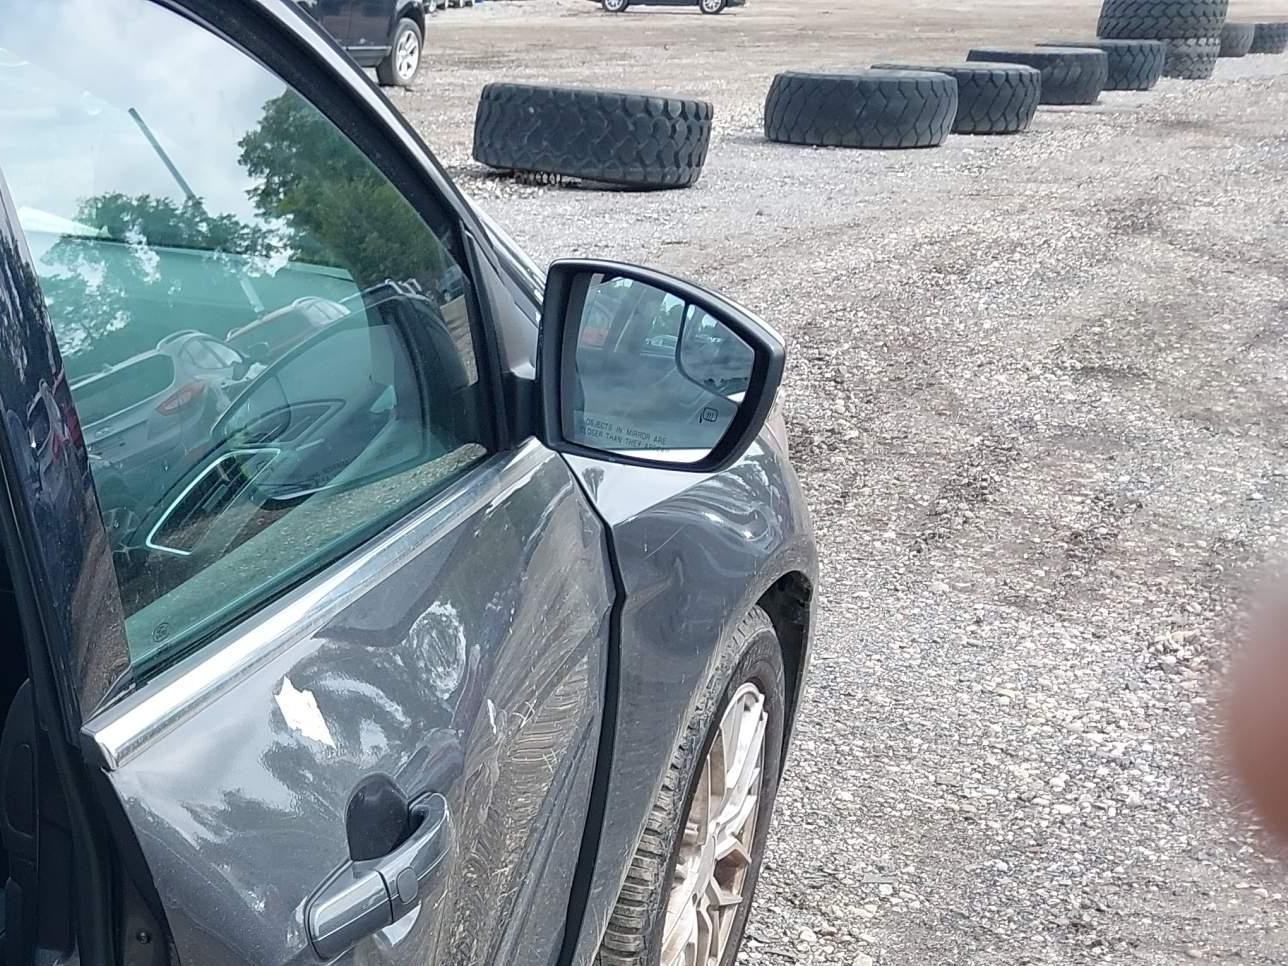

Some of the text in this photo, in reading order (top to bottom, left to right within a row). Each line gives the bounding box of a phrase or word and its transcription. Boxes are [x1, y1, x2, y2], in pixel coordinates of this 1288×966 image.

[606, 432, 623, 443] THAN
[625, 438, 642, 448] THEY
[626, 428, 651, 440] MIRROR
